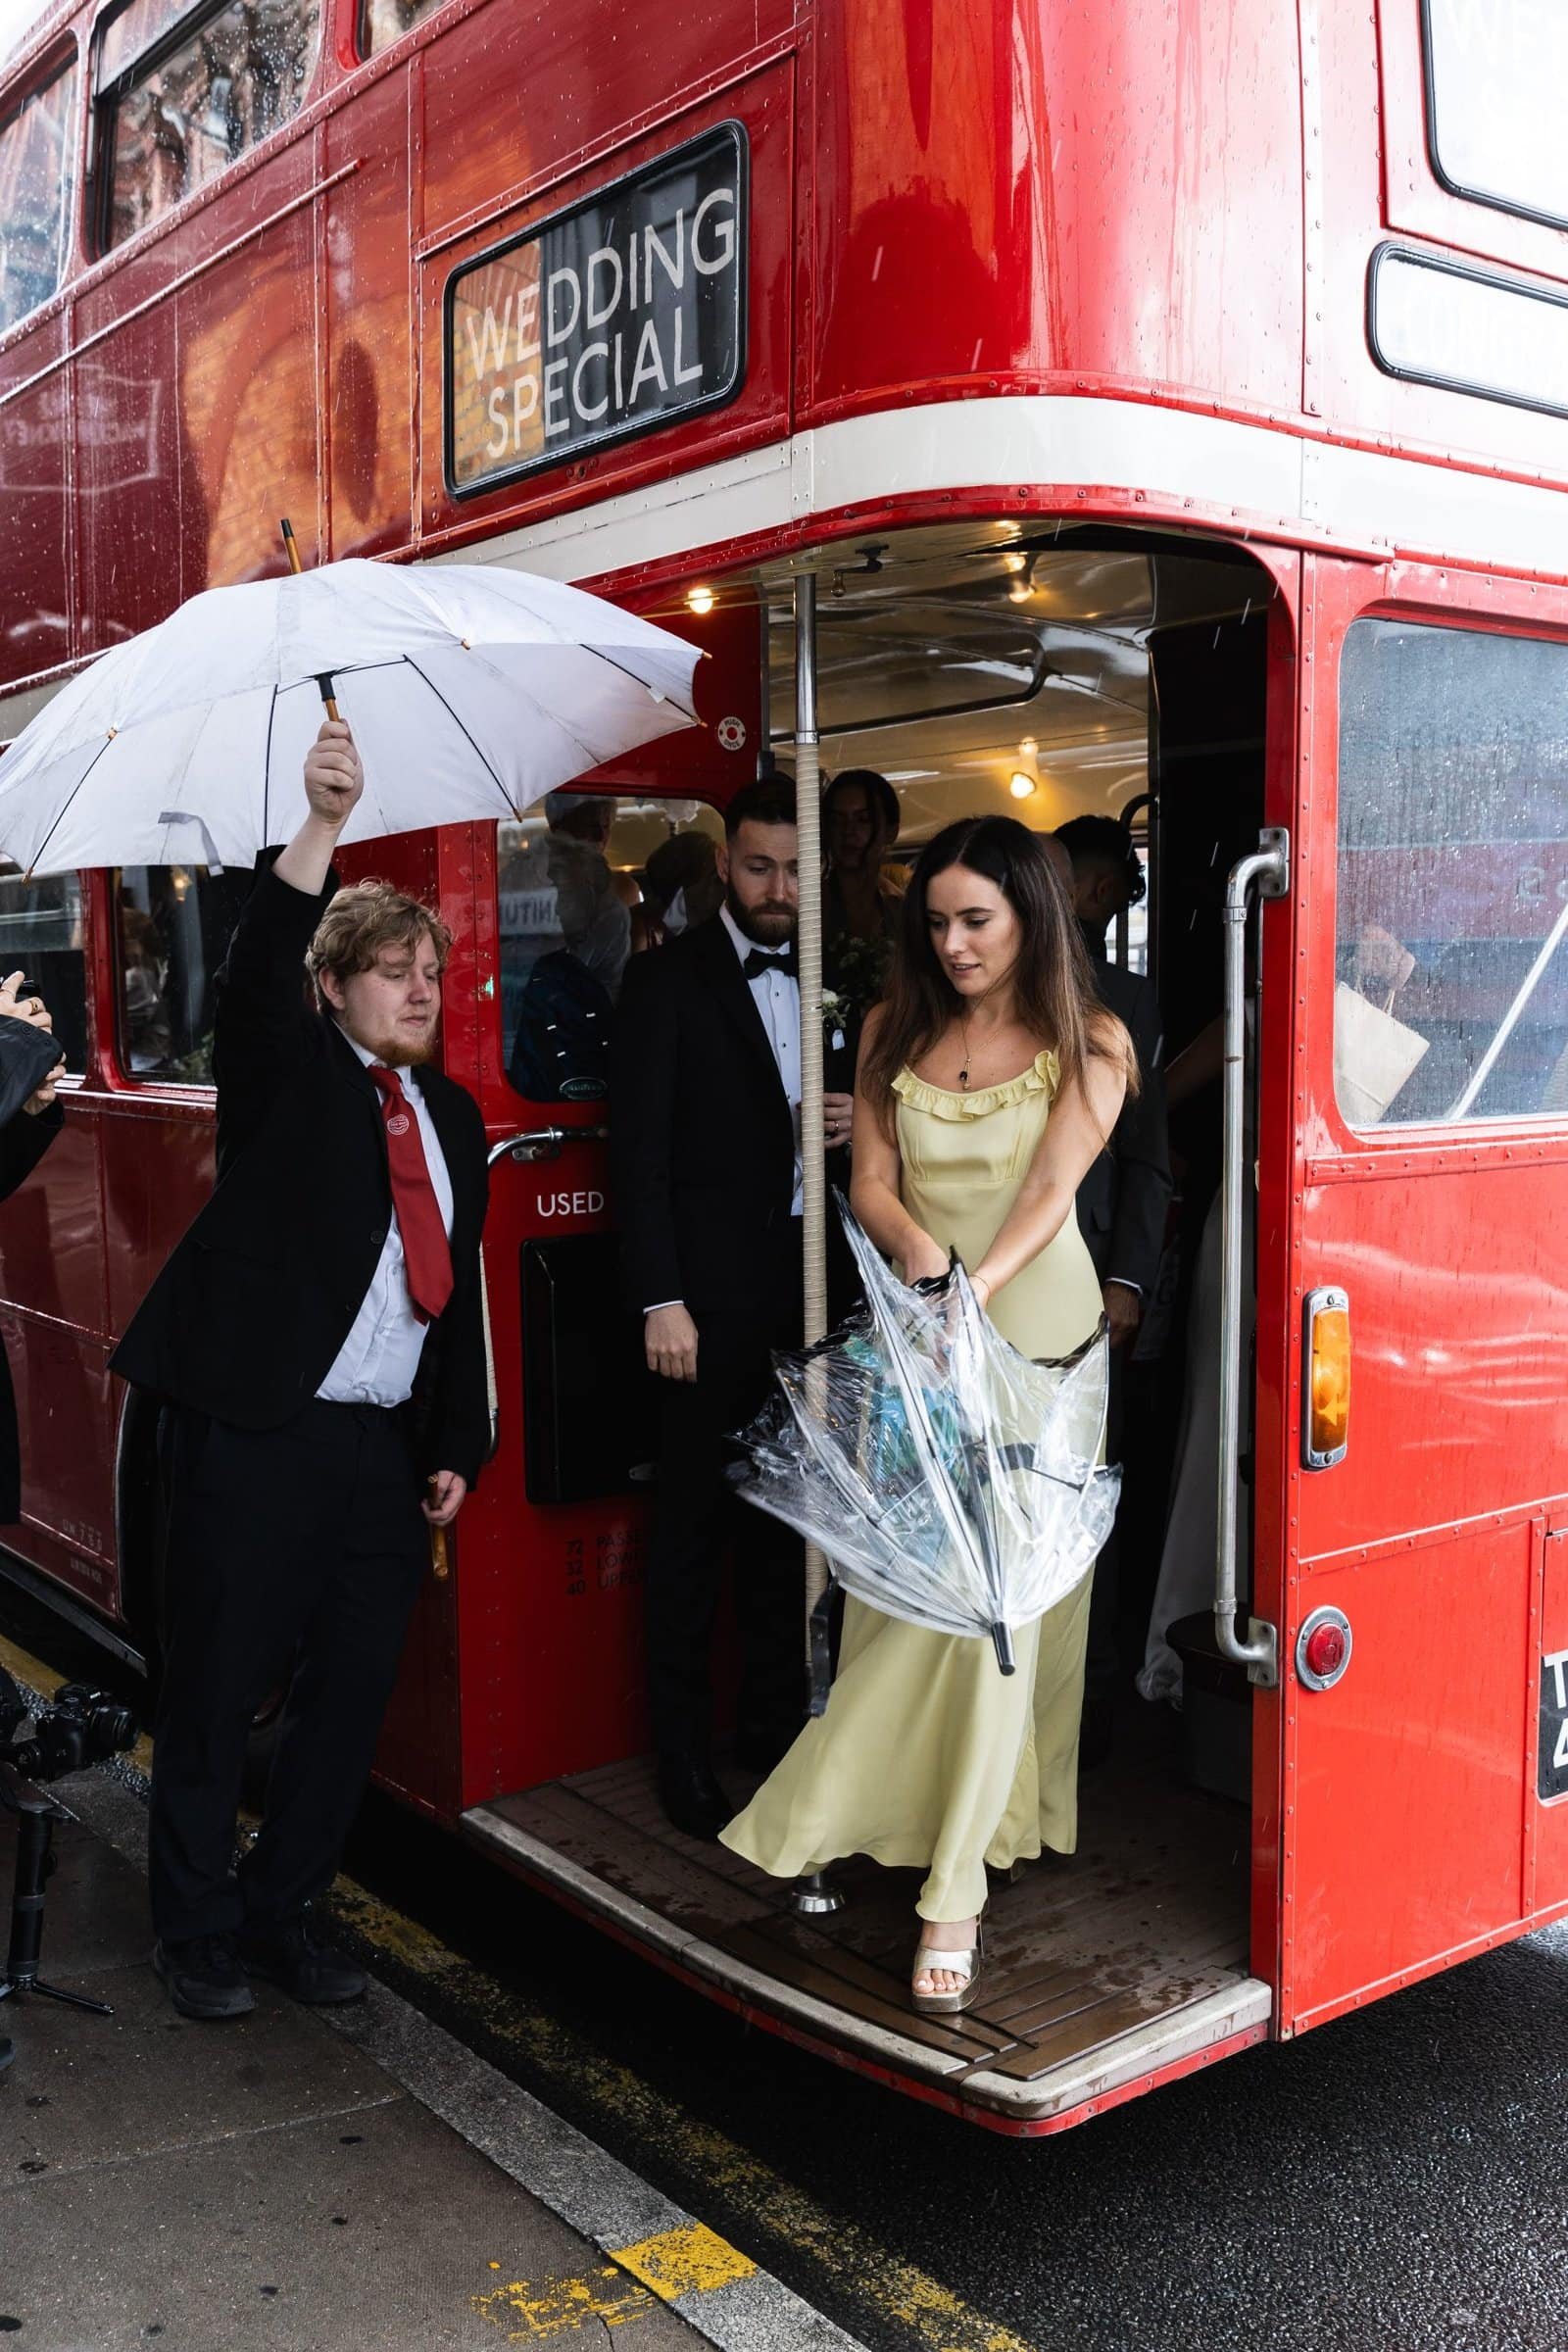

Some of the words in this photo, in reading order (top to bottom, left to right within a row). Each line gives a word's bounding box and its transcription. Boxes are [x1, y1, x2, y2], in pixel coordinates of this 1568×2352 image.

[466, 187, 735, 381] WEDDING
[486, 307, 704, 458] SPECIAL
[723, 717, 740, 727] PUSH
[723, 738, 741, 748] ONCE
[537, 1191, 605, 1217] USED
[564, 1578, 587, 1595] 40
